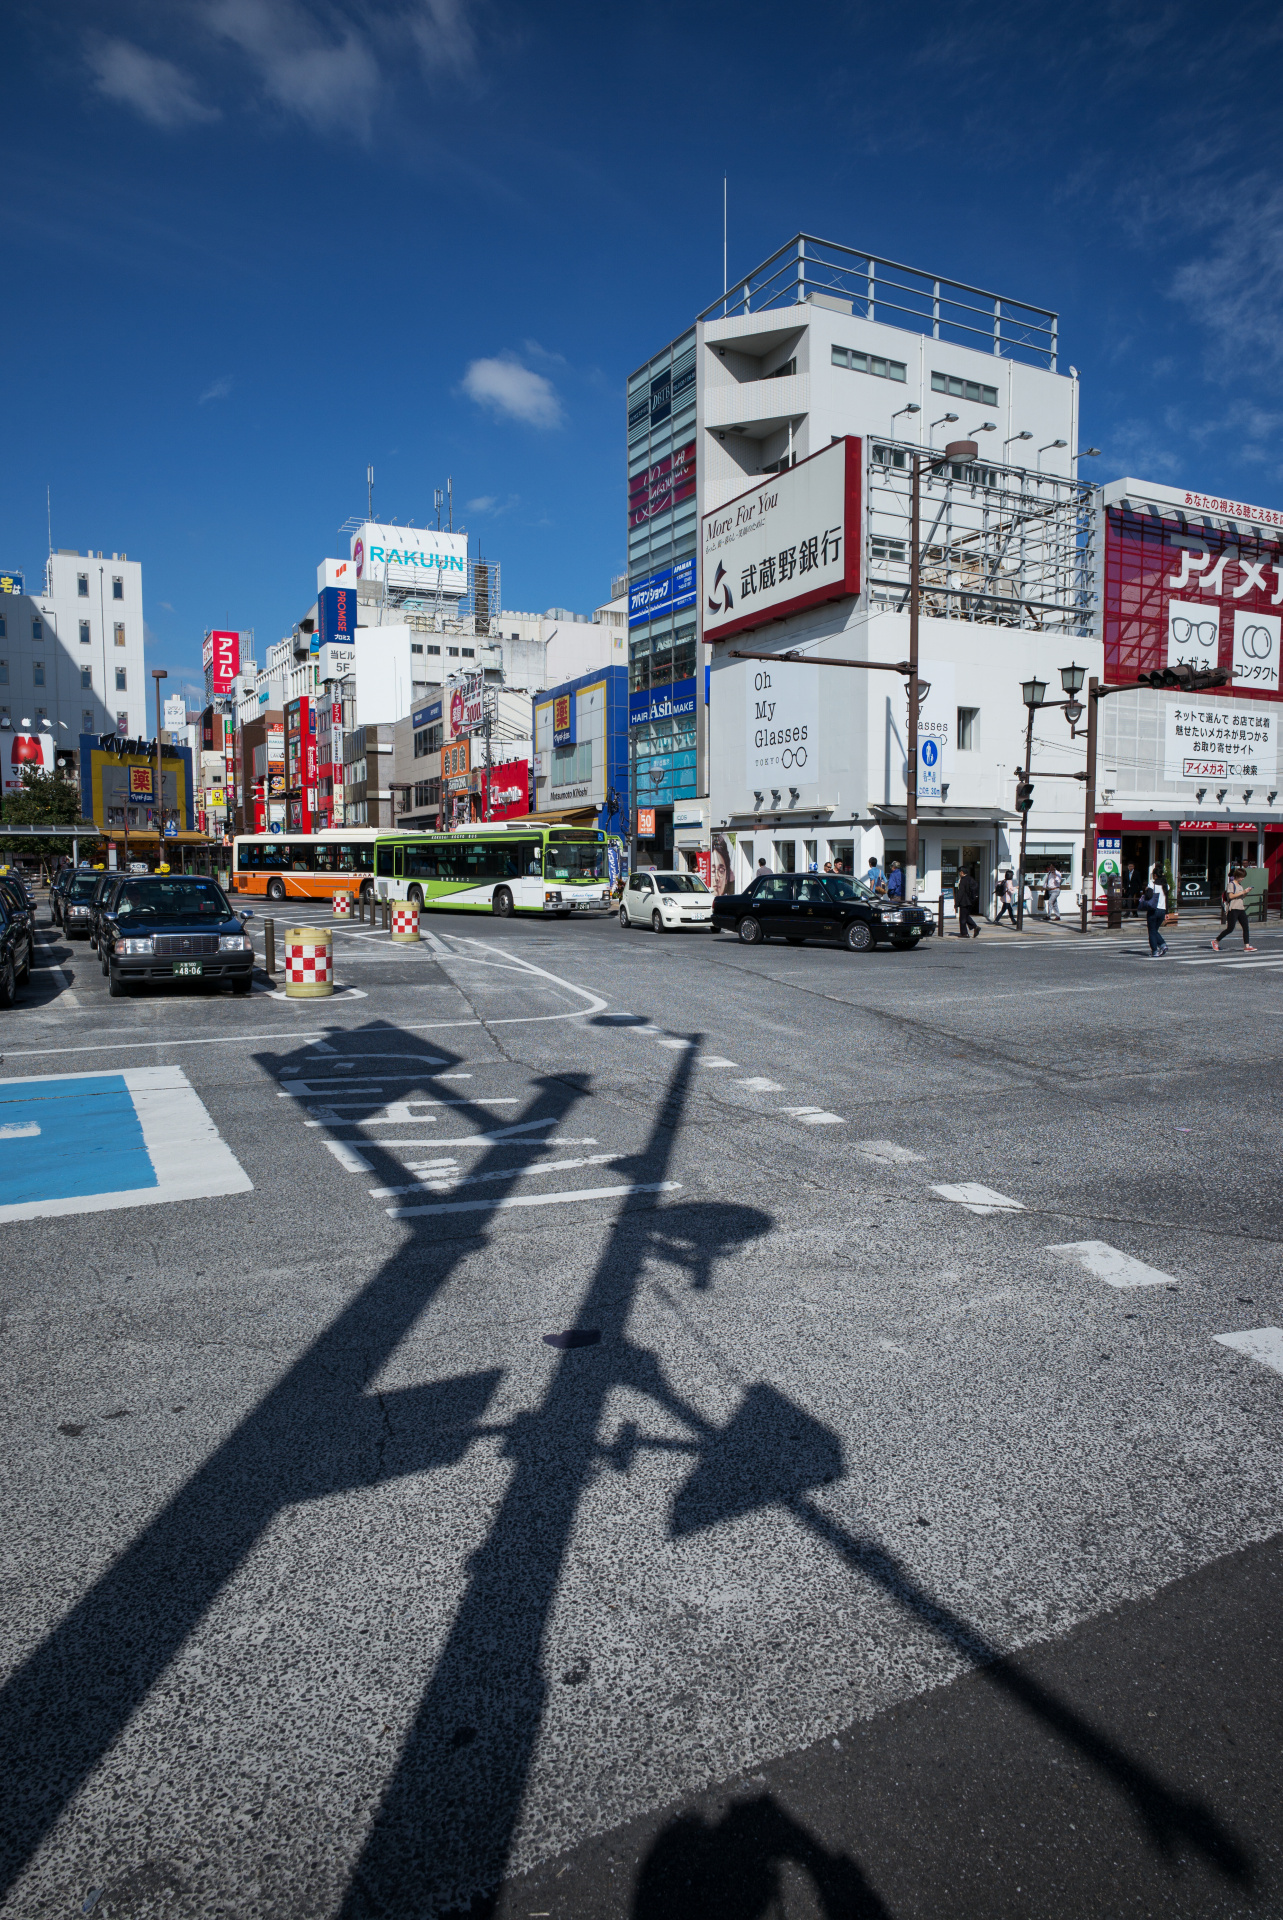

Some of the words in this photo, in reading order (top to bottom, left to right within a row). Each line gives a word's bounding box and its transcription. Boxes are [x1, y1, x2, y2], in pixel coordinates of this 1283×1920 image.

[706, 518, 733, 542] More
[735, 504, 756, 528] For
[758, 491, 779, 516] You
[370, 545, 464, 572] RAKUUN
[673, 560, 692, 574] APAMAN
[740, 524, 843, 600] 武蔵野銀行
[631, 580, 669, 610] アパマンショップ
[337, 590, 347, 632] PROMISE
[218, 637, 234, 678] アコム
[330, 649, 356, 660] 当ビル
[1176, 655, 1211, 671] メガネ
[336, 662, 351, 673] 5F
[1235, 663, 1279, 683] コンタクト
[754, 671, 772, 691] Oh
[556, 697, 568, 729] 薬
[631, 711, 649, 724] HAIR
[649, 696, 673, 719] Ash
[673, 701, 694, 714] MAKE
[755, 701, 777, 721] My
[1174, 709, 1229, 725] ネットで選んで
[1232, 715, 1270, 729] お店で試着
[119, 722, 127, 730] ケ
[1175, 725, 1269, 743] 魅せたいメガネが見つかる
[754, 725, 808, 748] Glasses
[1192, 741, 1254, 756] お取り寄せサイト
[755, 756, 780, 766] TOKYO
[1186, 762, 1225, 776] アイメガネ
[1243, 764, 1258, 777] 検索
[133, 769, 151, 791] 薬
[640, 814, 652, 828] 50
[179, 966, 201, 975] 48-06
